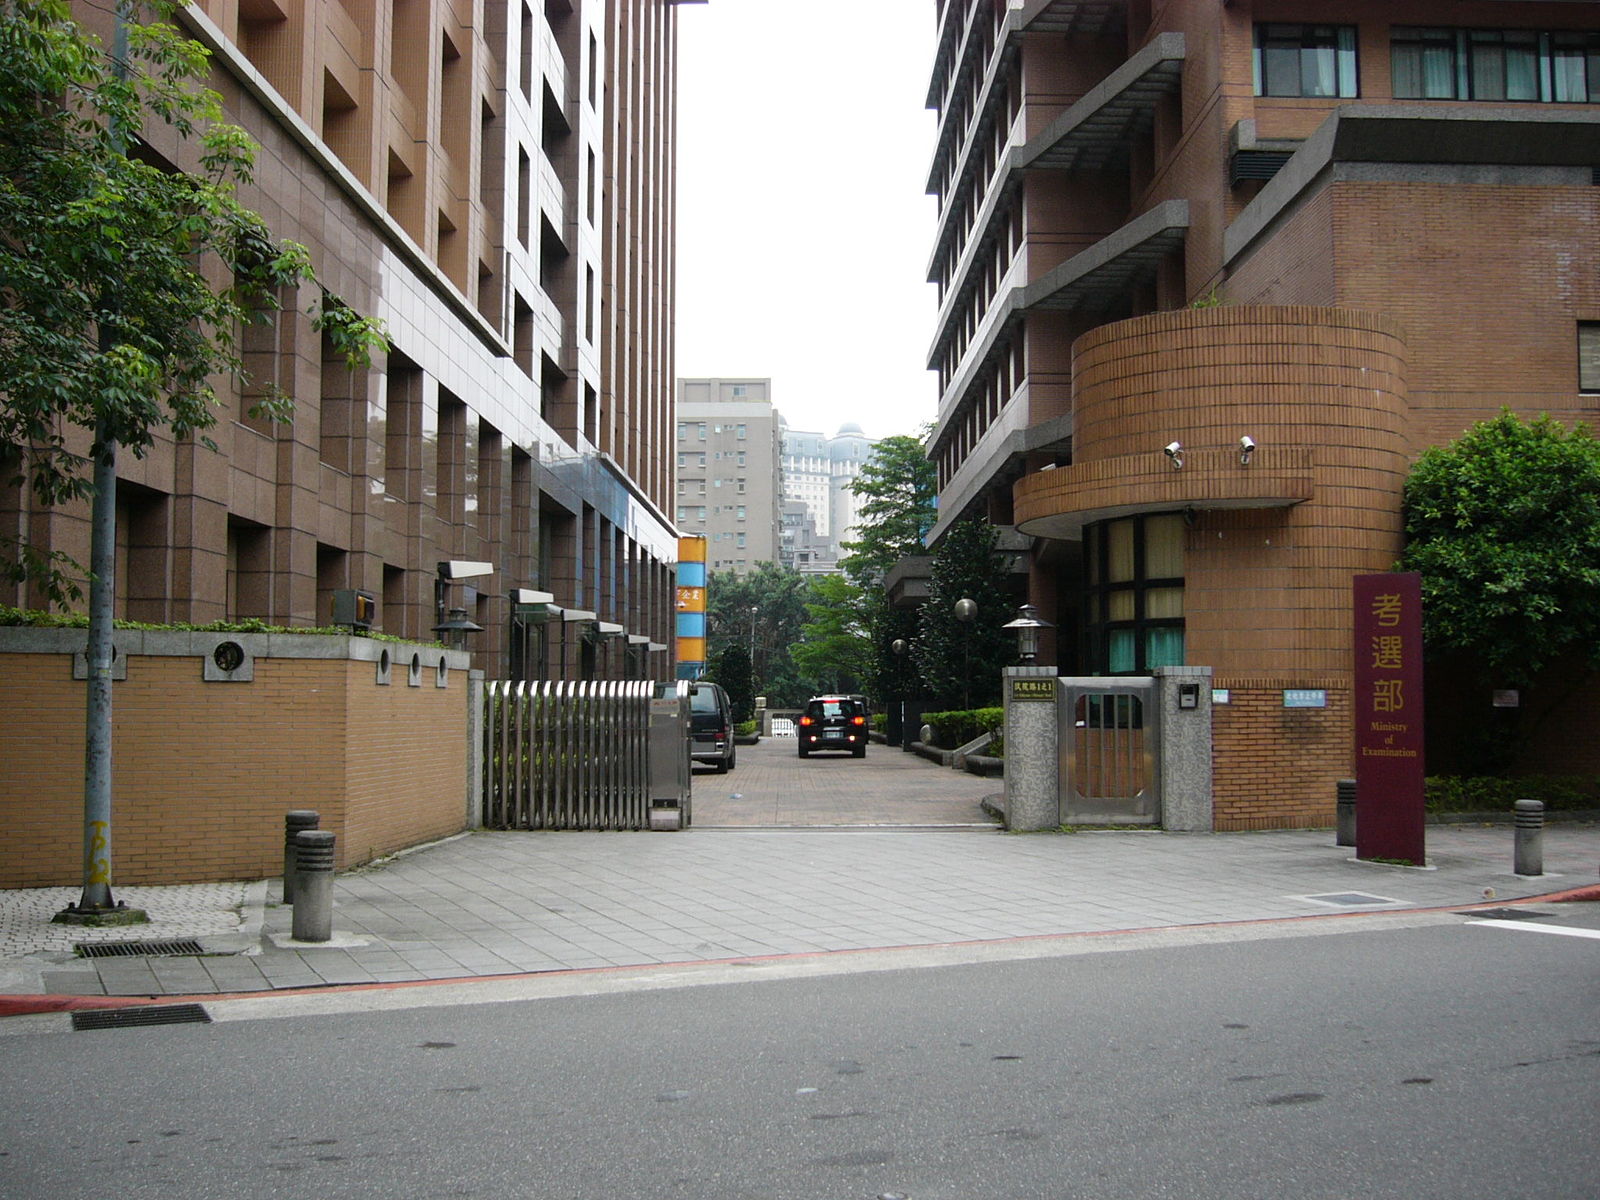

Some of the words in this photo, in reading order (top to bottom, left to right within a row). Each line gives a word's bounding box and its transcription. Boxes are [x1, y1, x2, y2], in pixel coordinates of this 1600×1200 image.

[1372, 593, 1404, 712] 考選部
[1371, 721, 1408, 733] Ministry
[1384, 734, 1394, 745] of
[1362, 746, 1417, 757] Examination
